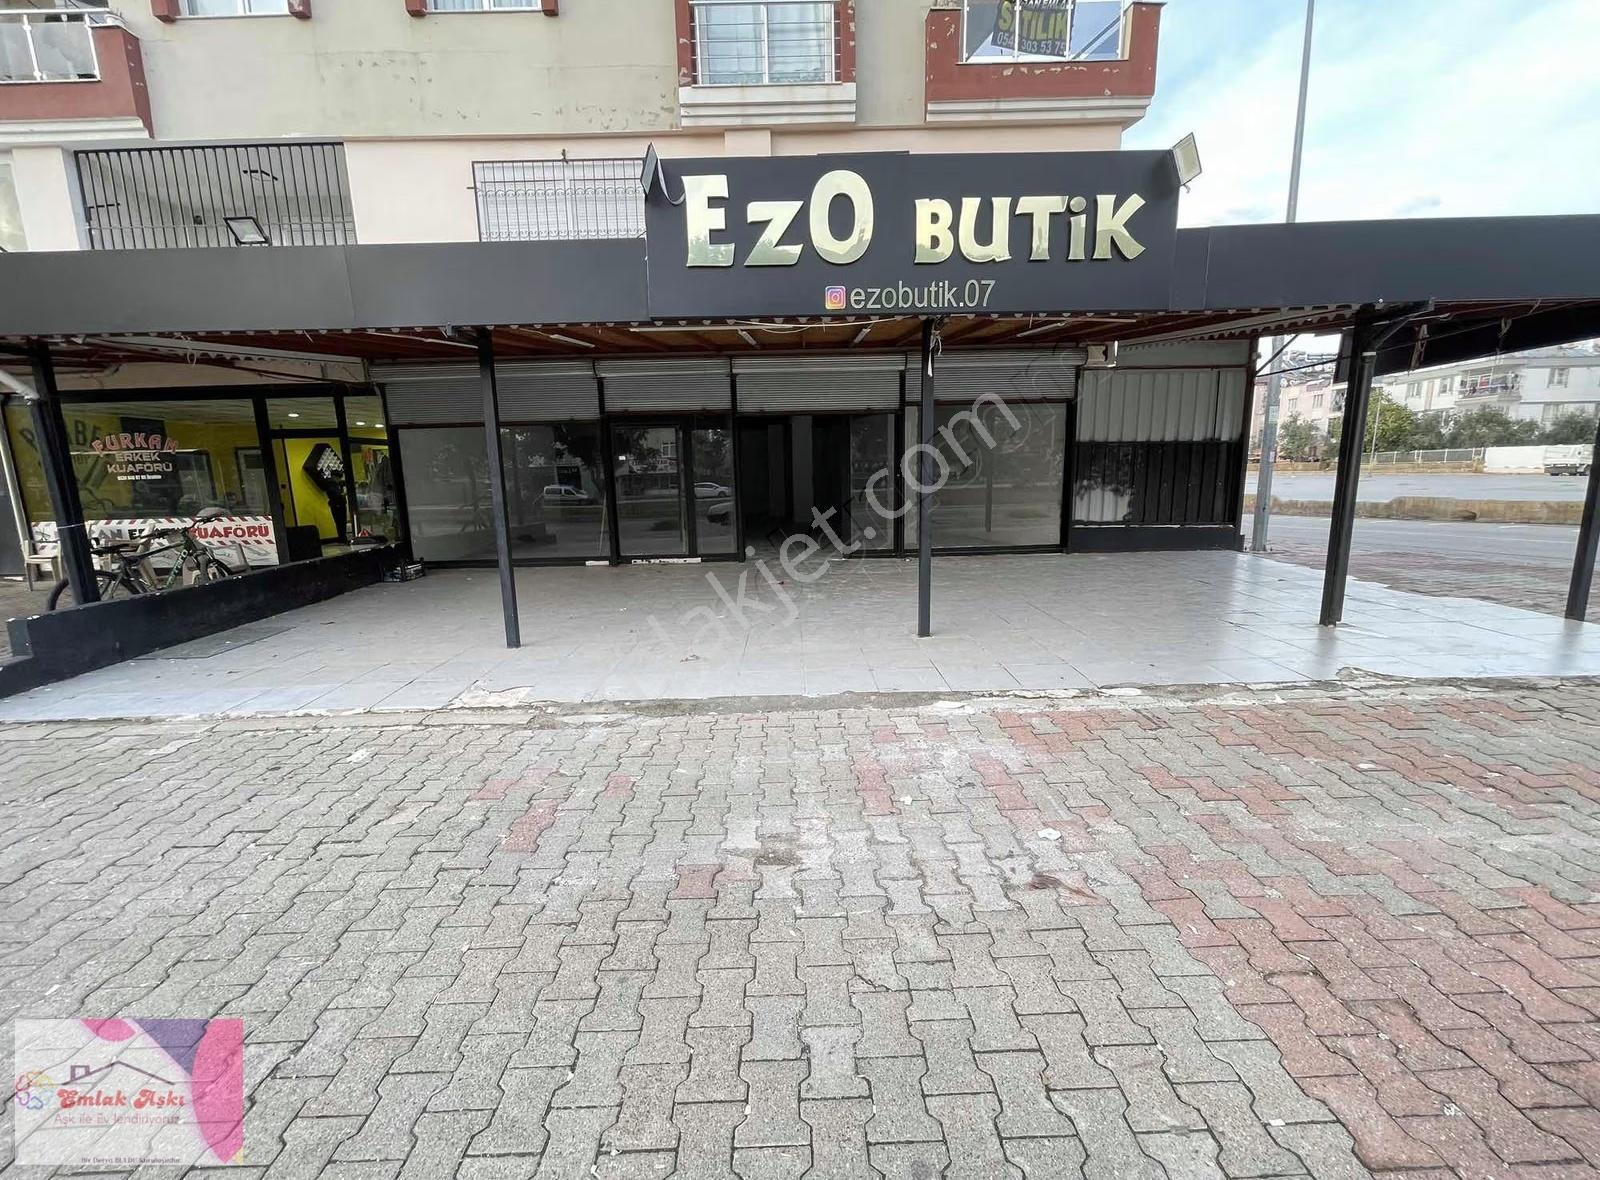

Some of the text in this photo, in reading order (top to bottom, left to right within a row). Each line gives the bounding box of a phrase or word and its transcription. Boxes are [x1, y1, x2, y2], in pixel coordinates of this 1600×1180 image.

[850, 279, 996, 309] ezobutik.07
[92, 432, 179, 457] FURKAN
[115, 451, 161, 462] ERKEK
